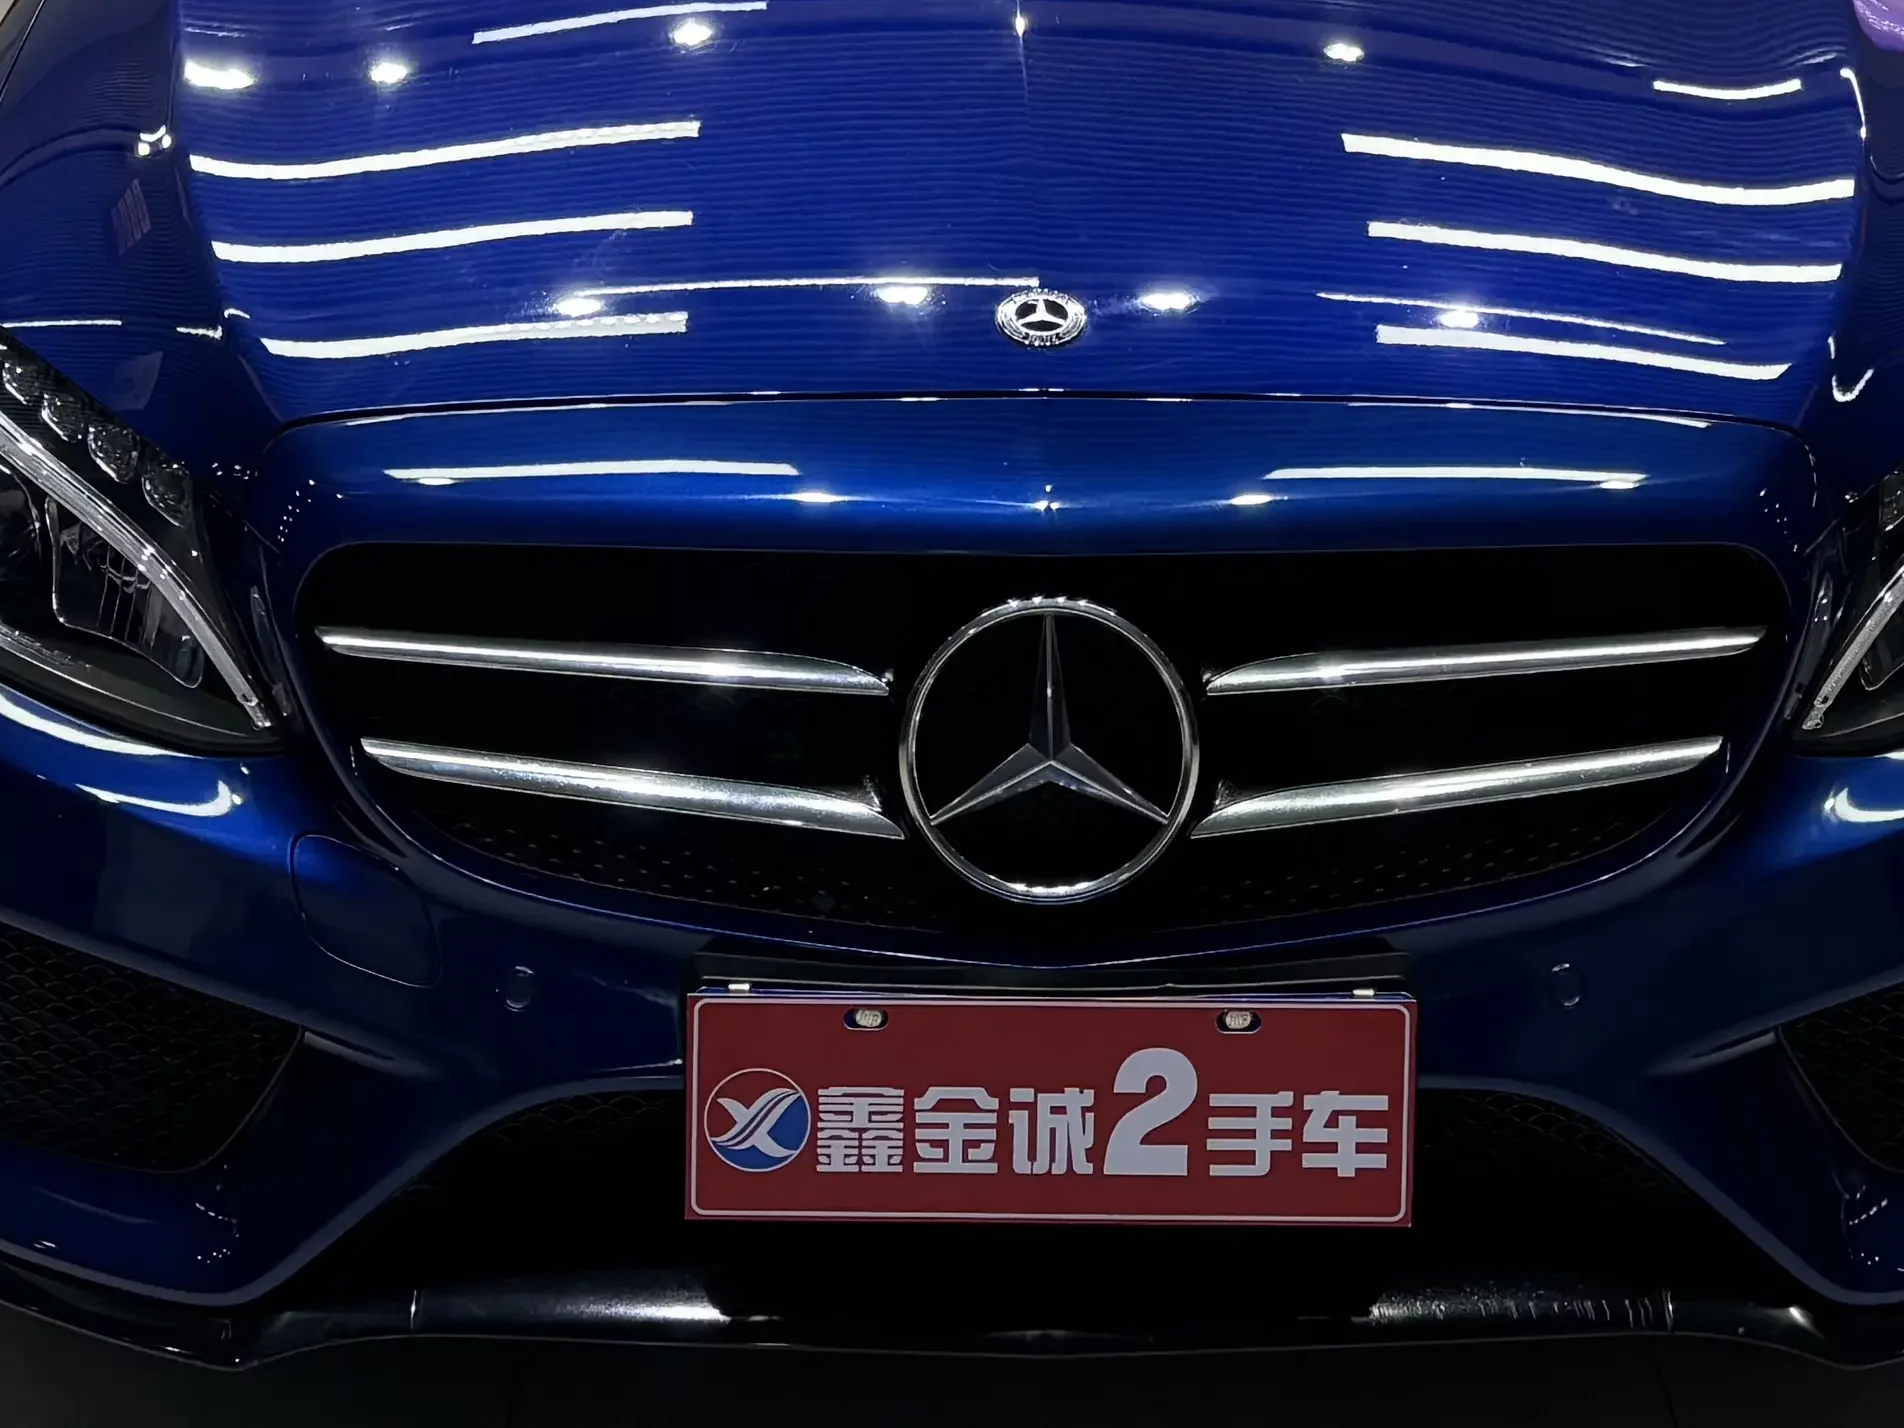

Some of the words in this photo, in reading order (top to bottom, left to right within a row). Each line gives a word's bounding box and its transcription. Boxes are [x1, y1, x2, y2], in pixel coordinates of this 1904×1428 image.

[816, 1047, 1390, 1178] 鑫金诚2手车
